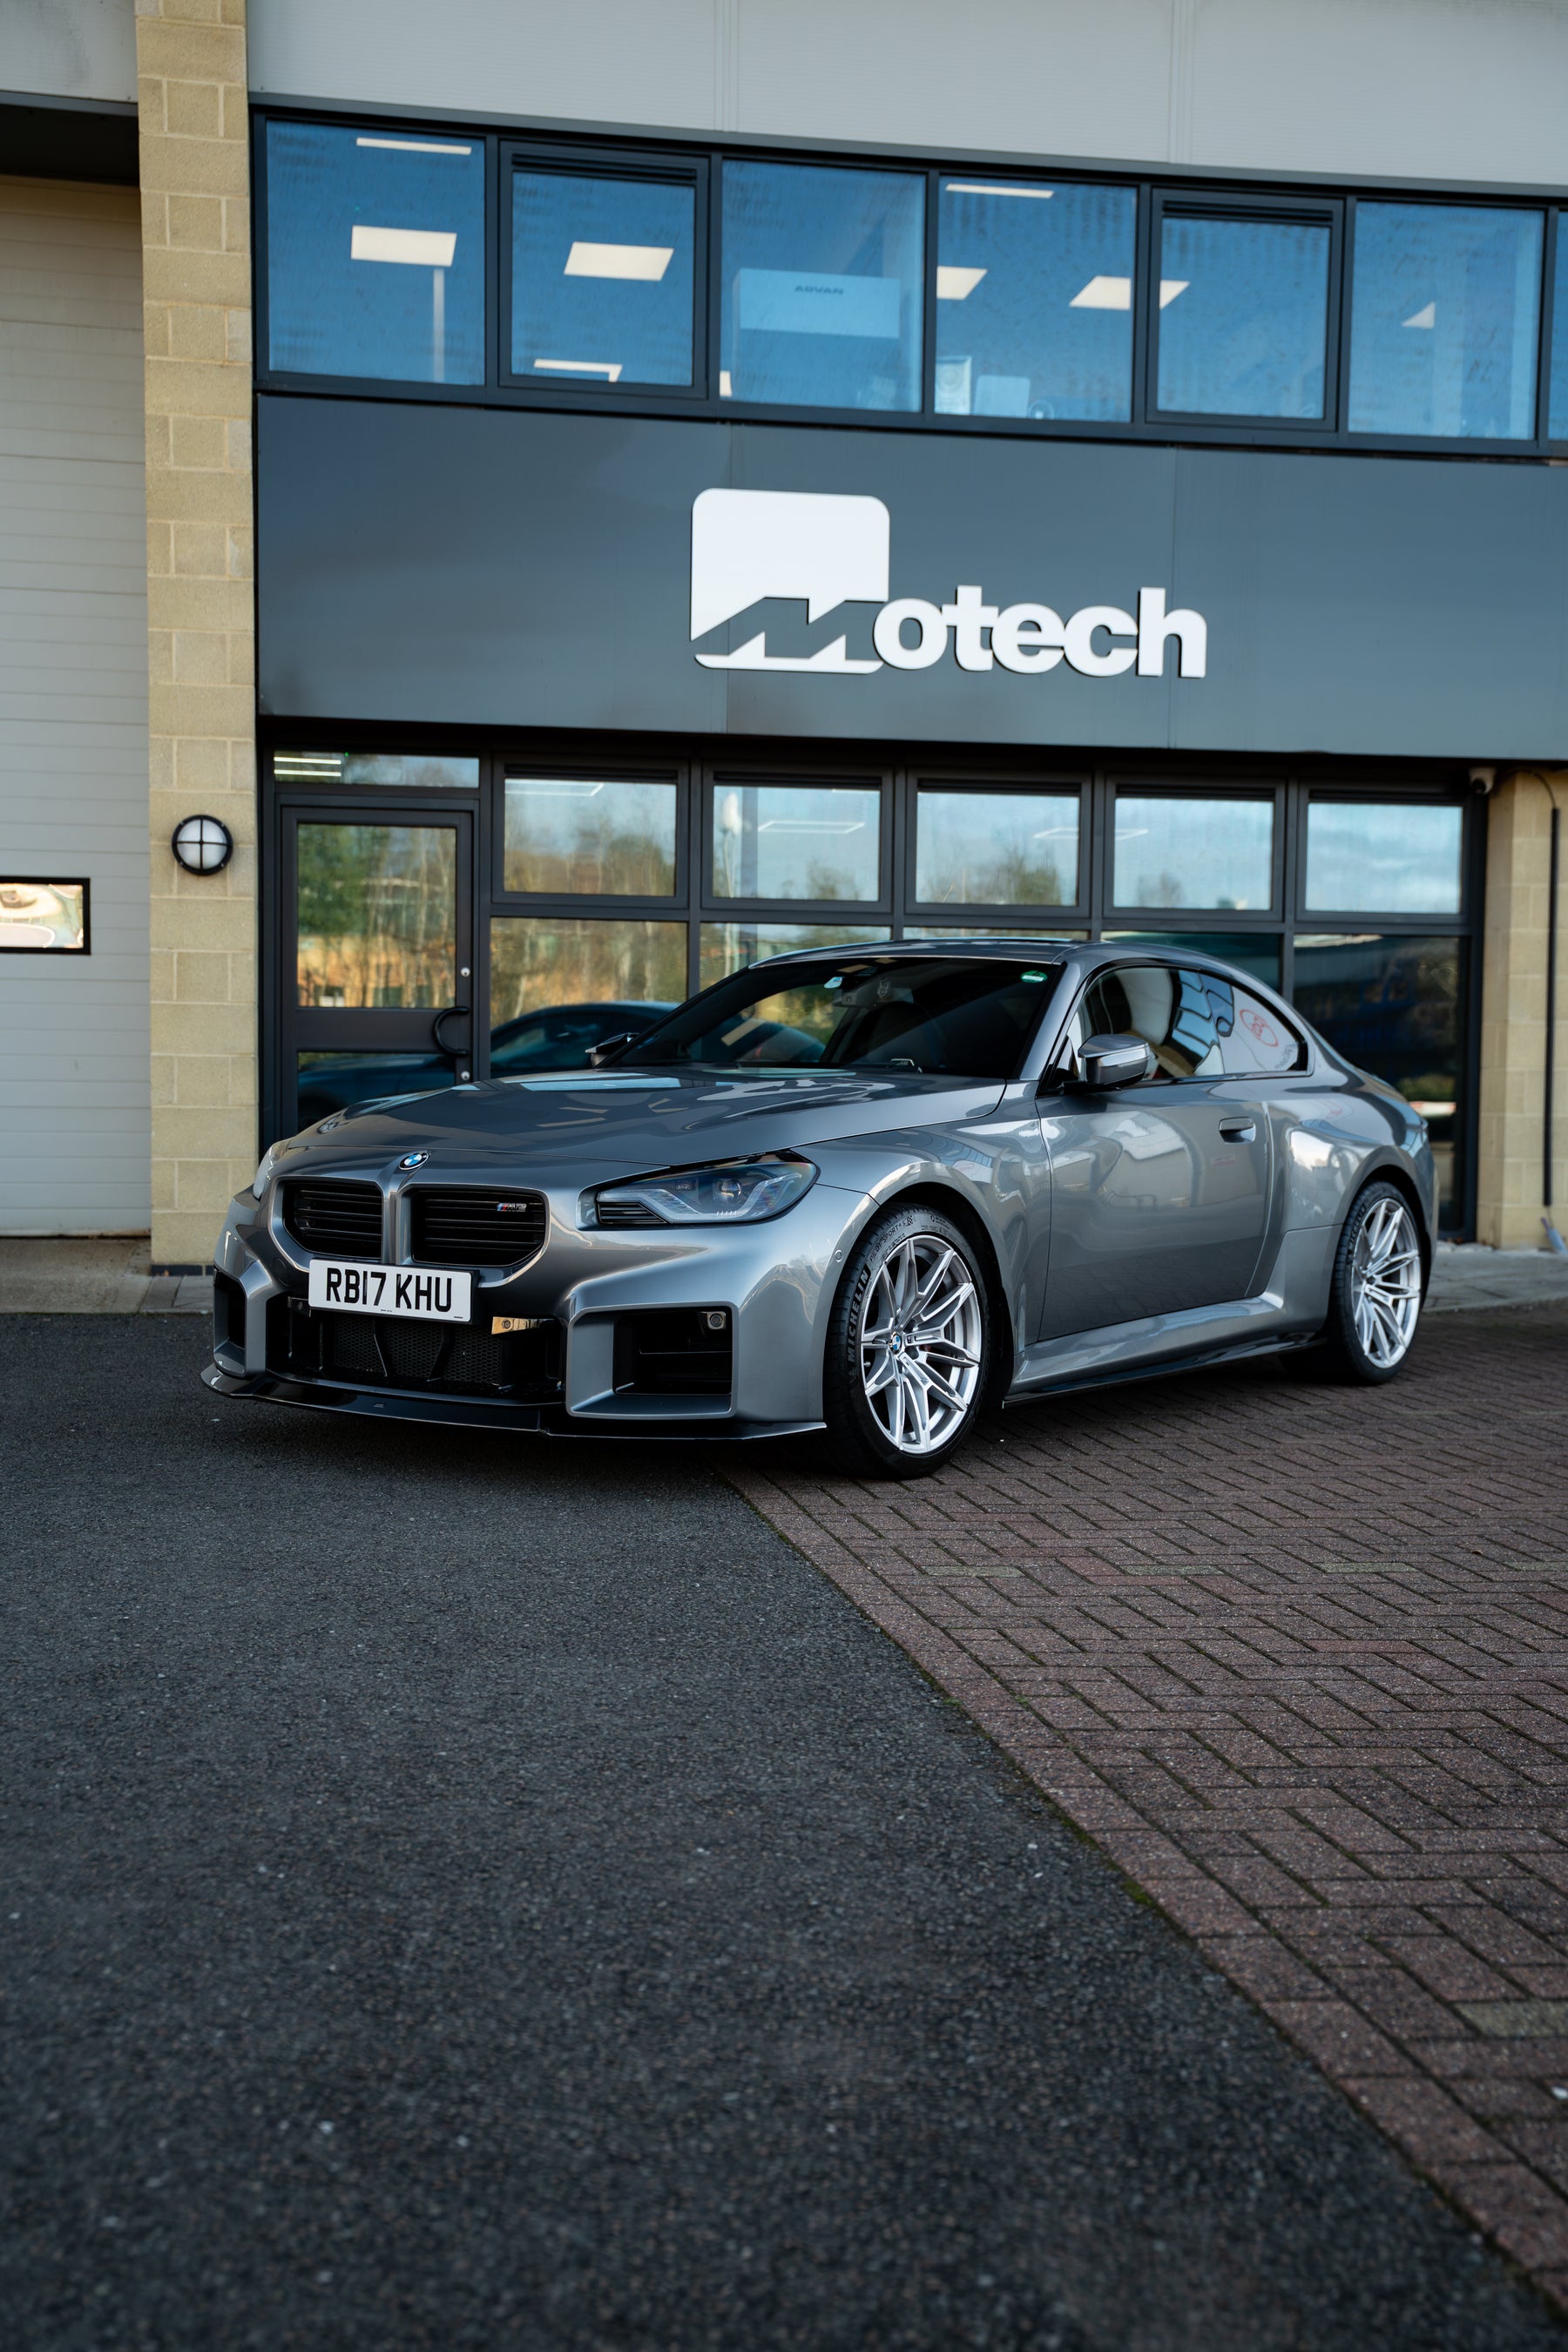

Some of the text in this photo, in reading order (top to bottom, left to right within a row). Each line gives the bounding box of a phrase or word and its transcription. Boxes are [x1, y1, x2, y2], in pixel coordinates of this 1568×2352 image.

[794, 285, 844, 295] ADVAN
[882, 1225, 899, 1243] SPORT
[326, 1267, 452, 1313] RB17 KHU
[848, 1268, 869, 1362] MICHELIN
